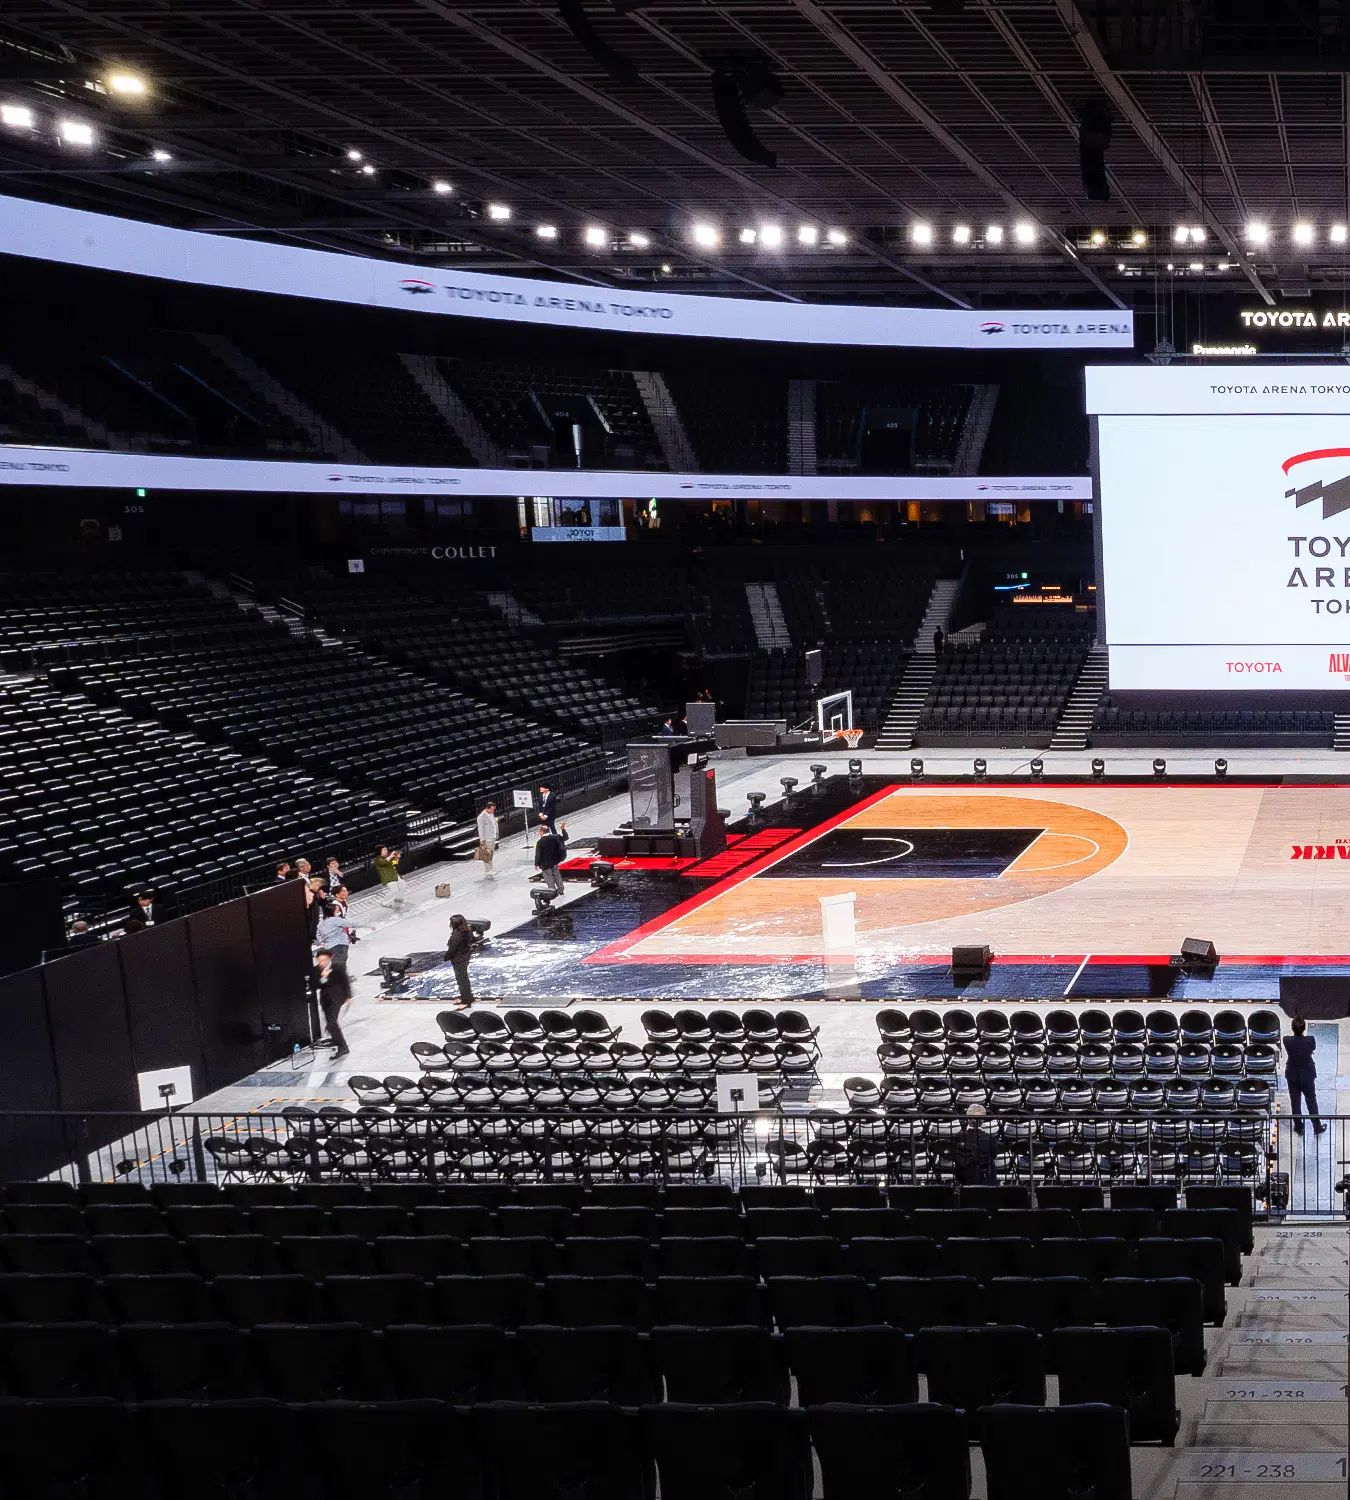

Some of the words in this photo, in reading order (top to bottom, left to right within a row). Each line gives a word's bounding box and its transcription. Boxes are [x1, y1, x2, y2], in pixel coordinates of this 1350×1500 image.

[444, 286, 527, 306] TOYOTA
[533, 297, 606, 313] ARENA
[610, 303, 673, 319] TOKYO
[1240, 312, 1317, 326] TOYOTA
[1011, 324, 1071, 335] TOYOTA
[1075, 324, 1131, 335] ARENA
[1210, 385, 1258, 394] TOYOTA
[1262, 385, 1307, 394] ARENA
[1310, 385, 1350, 394] TOKYO
[124, 505, 145, 513] 305
[431, 546, 498, 559] COLLET
[1225, 662, 1282, 673] TOYOTA
